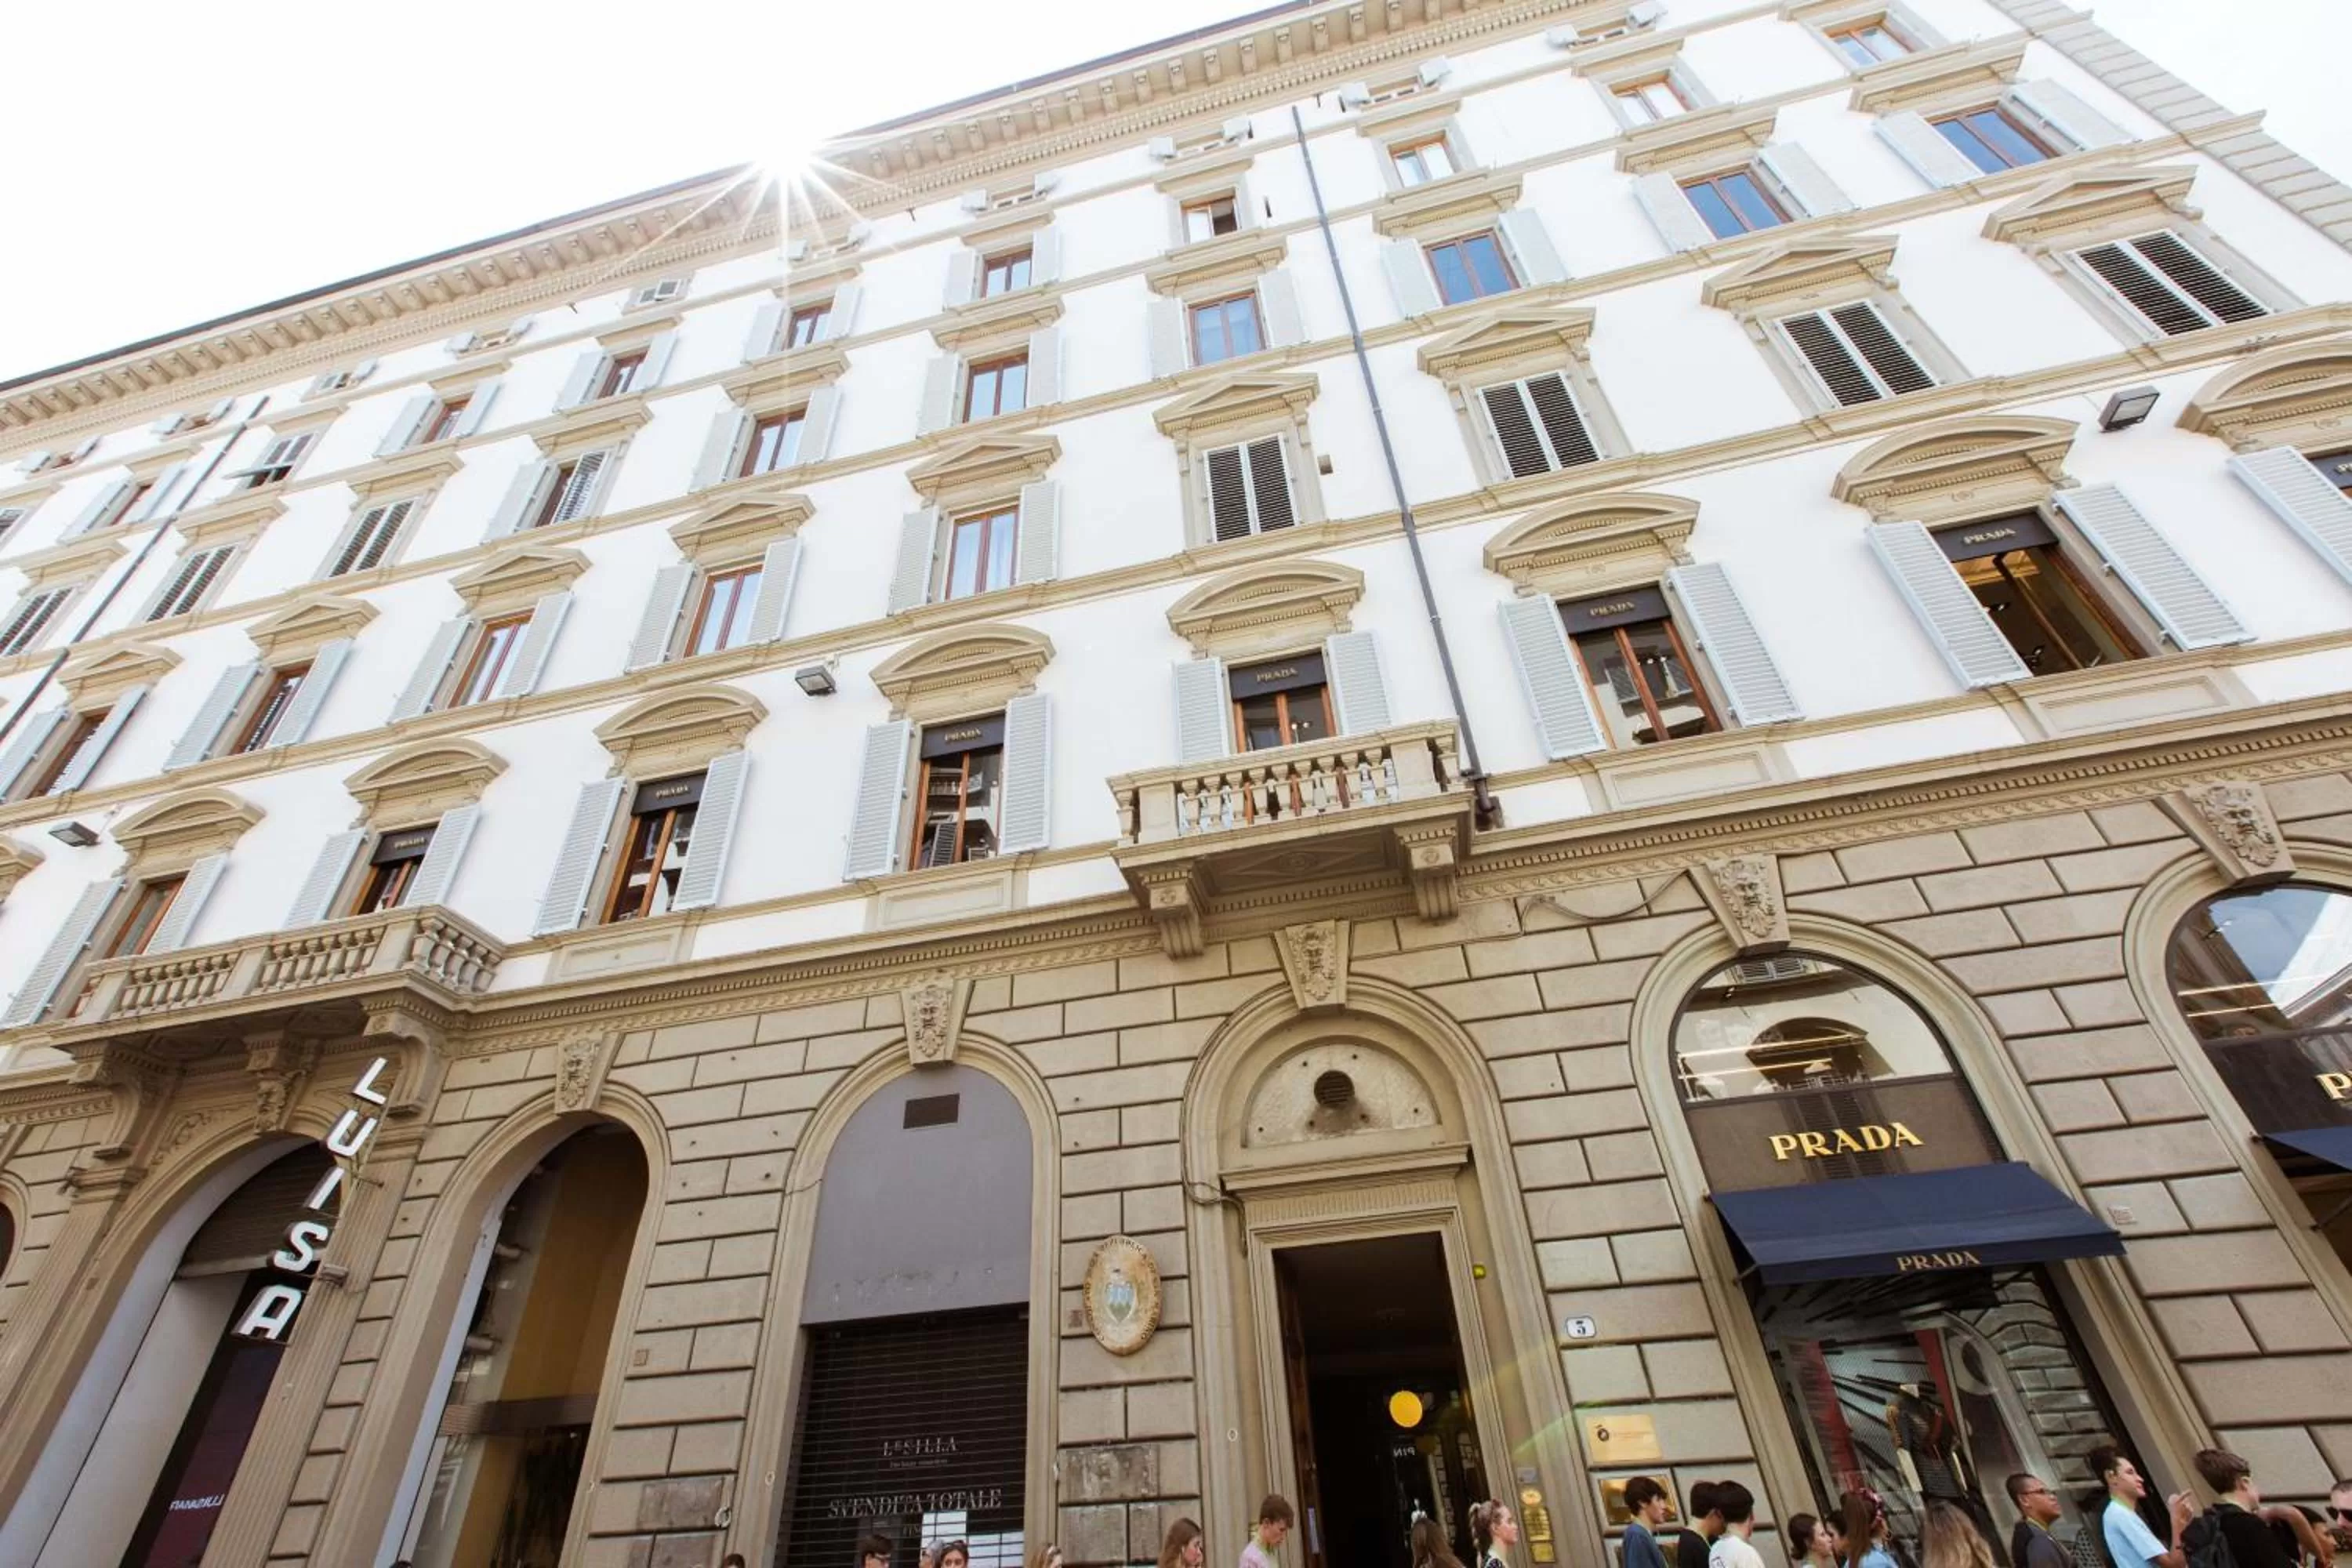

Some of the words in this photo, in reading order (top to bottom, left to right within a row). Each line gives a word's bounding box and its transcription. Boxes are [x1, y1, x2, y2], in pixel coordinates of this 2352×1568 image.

[1963, 528, 2016, 545] PRADA
[1768, 1122, 1925, 1161] PRADA
[235, 1057, 387, 1340] LUISA
[1896, 1250, 1981, 1272] PRADA
[828, 1493, 923, 1518] SVENDITA
[927, 1488, 1002, 1513] TOTALE
